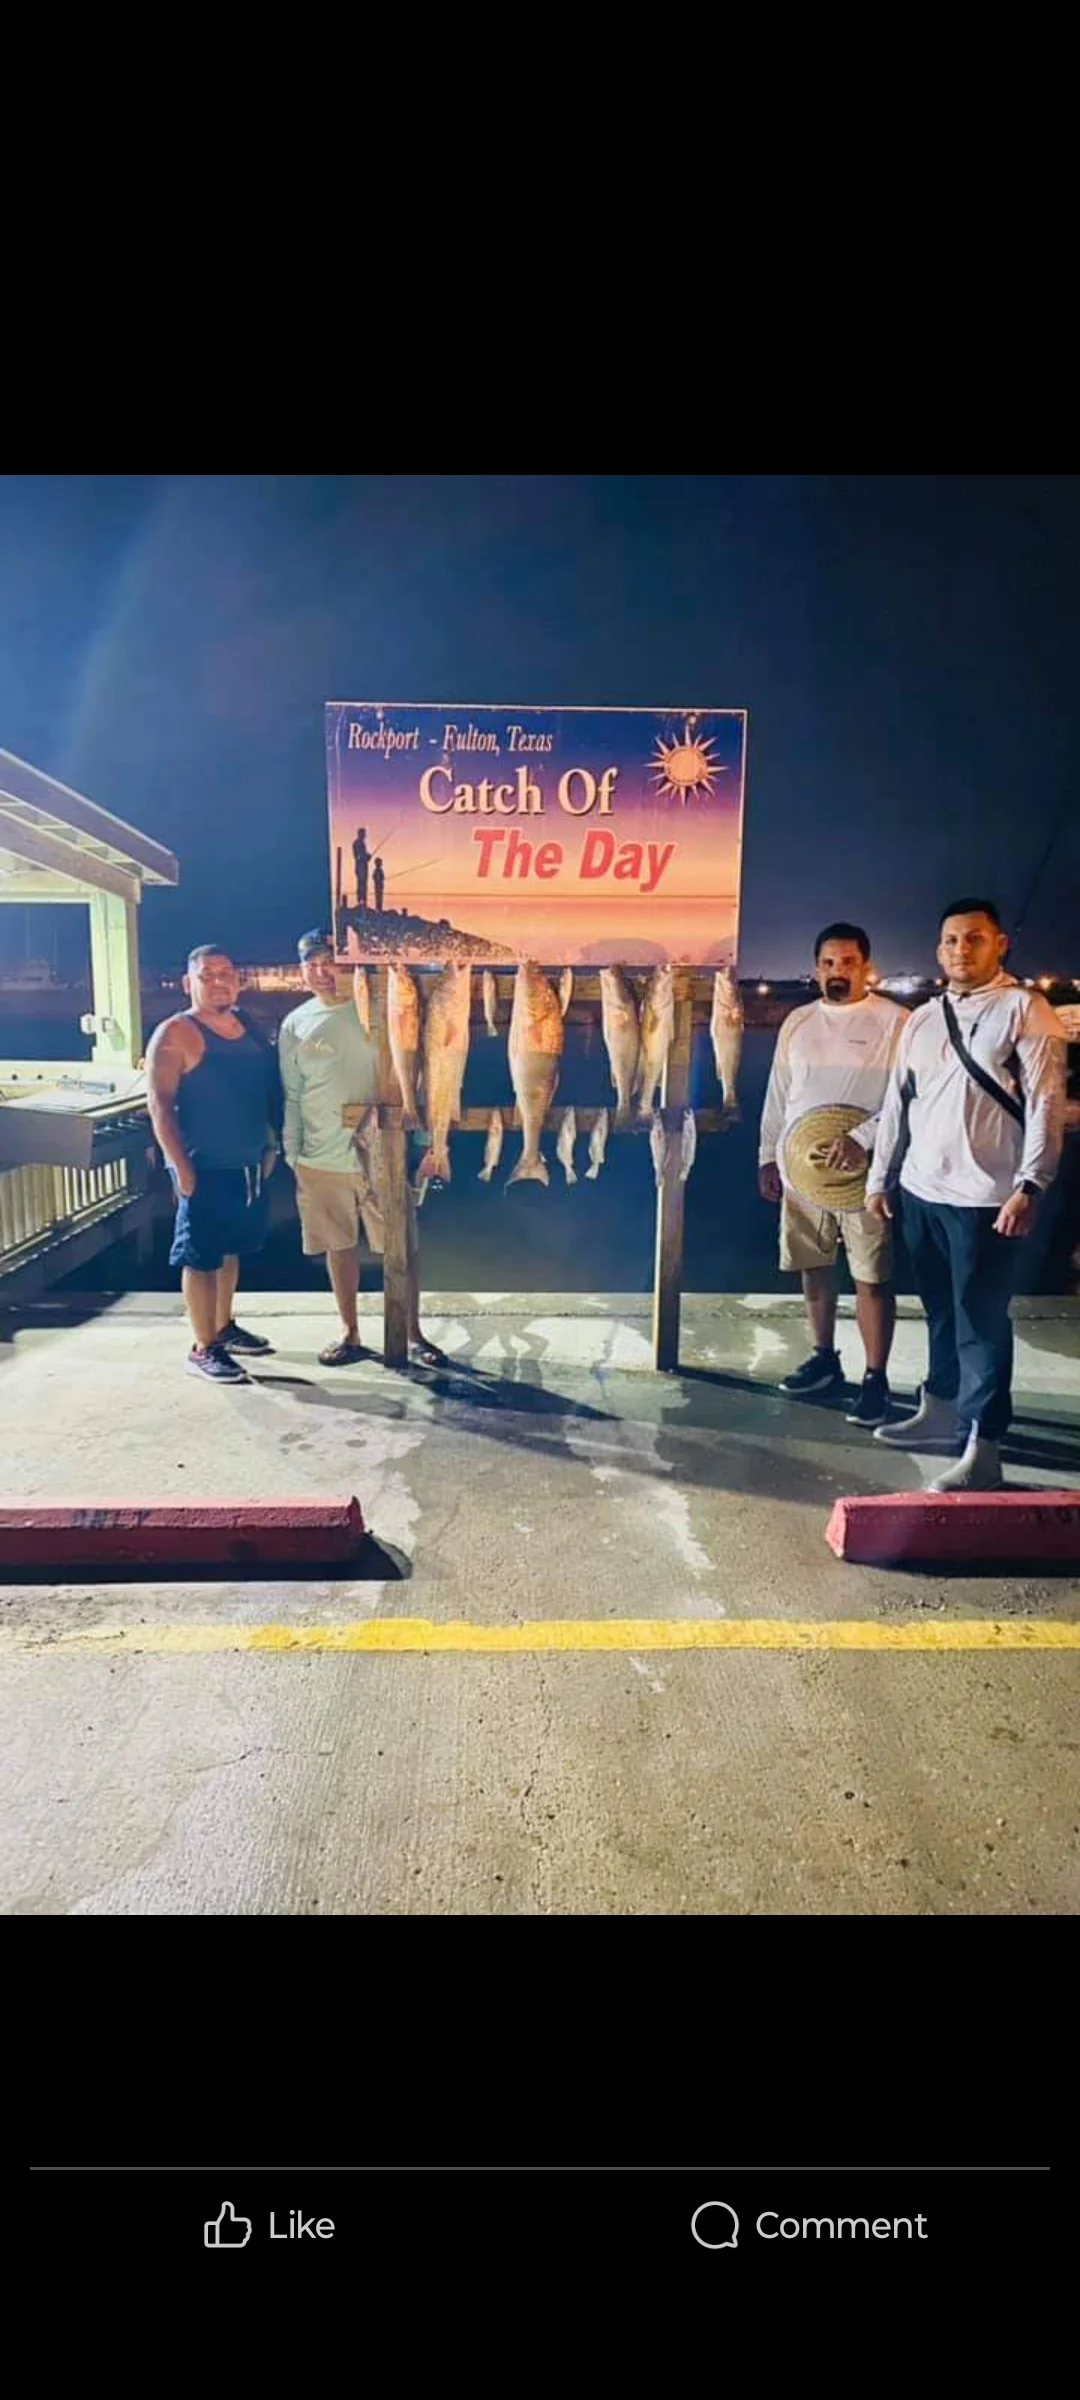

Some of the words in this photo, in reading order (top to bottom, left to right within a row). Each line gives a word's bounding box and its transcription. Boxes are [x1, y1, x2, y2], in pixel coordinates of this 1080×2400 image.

[348, 722, 420, 759] Rockport
[442, 723, 500, 756] Fulton,
[506, 725, 553, 752] Texas
[419, 765, 545, 814] Catch
[558, 768, 618, 815] Of
[472, 827, 563, 879] The
[579, 828, 675, 892] Day
